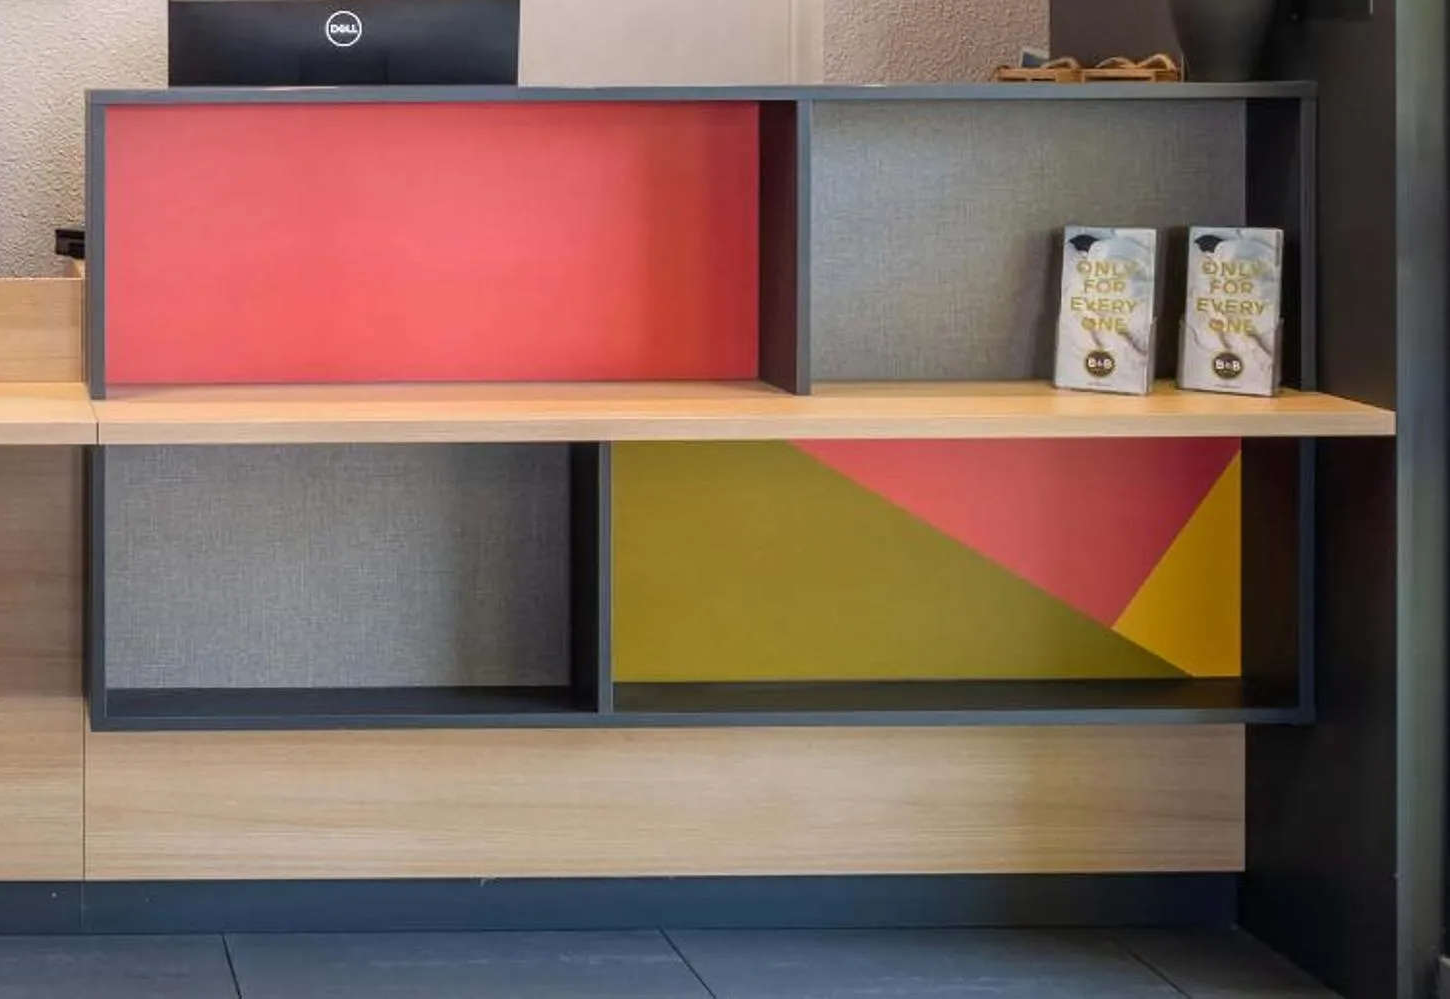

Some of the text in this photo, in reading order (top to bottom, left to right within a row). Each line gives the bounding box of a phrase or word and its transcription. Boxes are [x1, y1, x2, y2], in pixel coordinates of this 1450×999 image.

[330, 23, 358, 34] DELL
[1076, 259, 1138, 277] ONLY
[1201, 260, 1266, 277] ONLY
[1083, 278, 1127, 294] FOR
[1209, 279, 1254, 294] FOR
[1069, 296, 1139, 314] EVERY
[1196, 297, 1265, 315] EVERY
[1081, 316, 1128, 333] ONE
[1209, 318, 1253, 334] ONE
